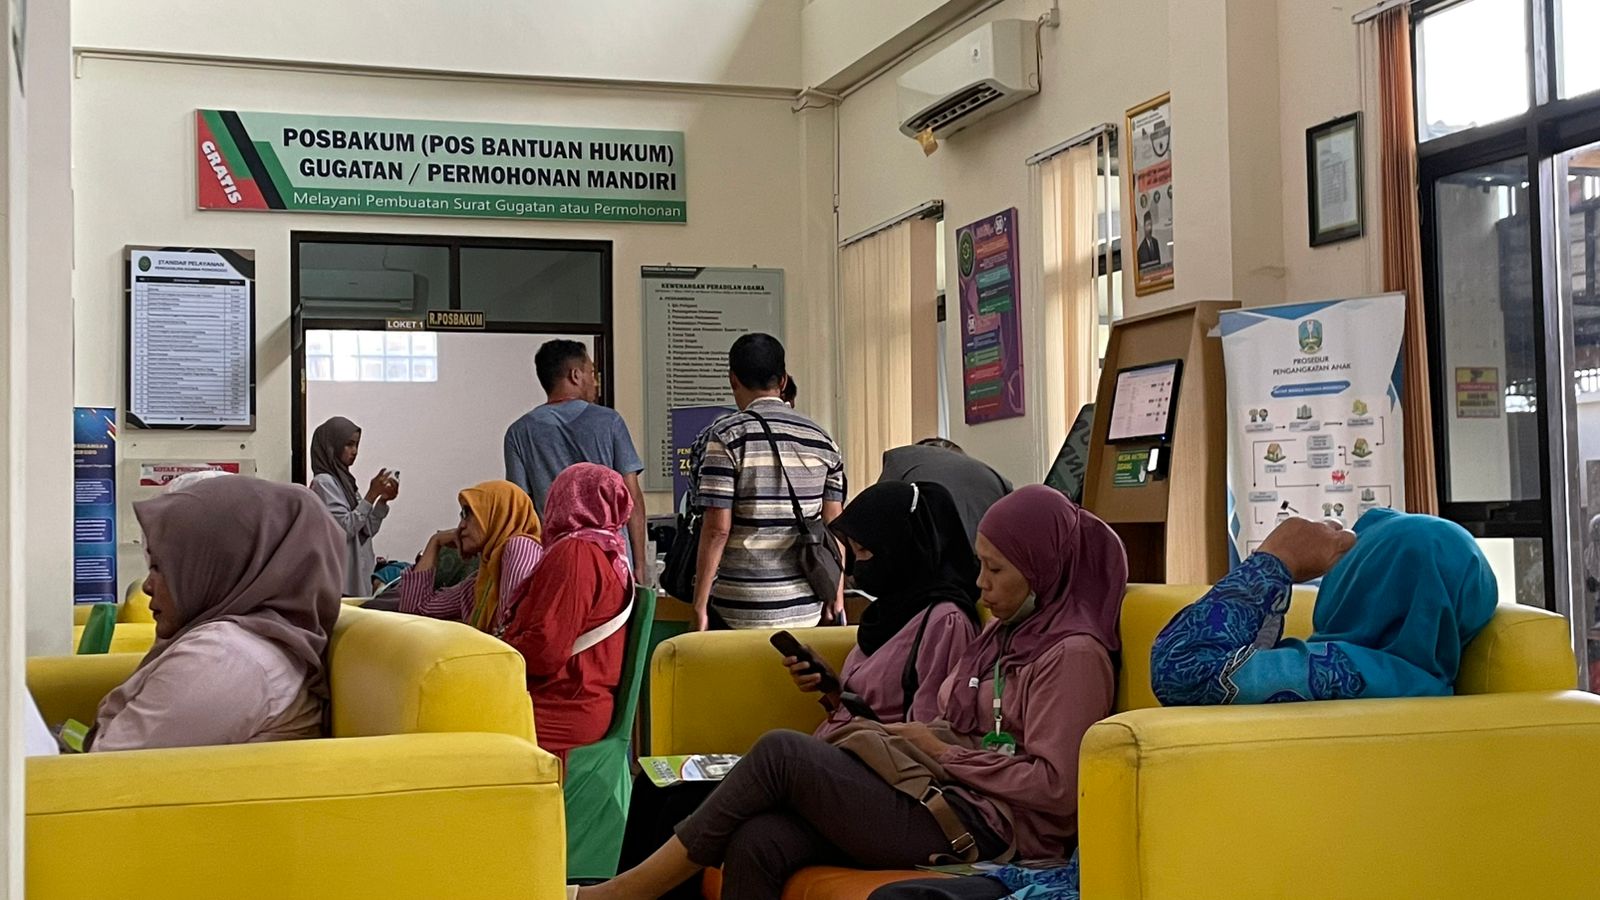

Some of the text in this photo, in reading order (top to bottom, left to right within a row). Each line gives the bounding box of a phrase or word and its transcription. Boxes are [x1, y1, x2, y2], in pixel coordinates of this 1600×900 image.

[283, 128, 674, 167] POSBAKUM (POS BANTUAN HUKUM)
[201, 140, 242, 205] GRATIS
[299, 158, 676, 191] GUGATAN / PERMOHONAN MANDIRI
[293, 191, 681, 217] Melayani Pembuatan Surat Gugatan atau Permohonan
[387, 320, 417, 329] LOKET
[429, 312, 483, 326] R.POSBAKUM
[1273, 362, 1351, 376] PENGANGKATAN ANAK
[1293, 355, 1329, 365] PROSEDUR
